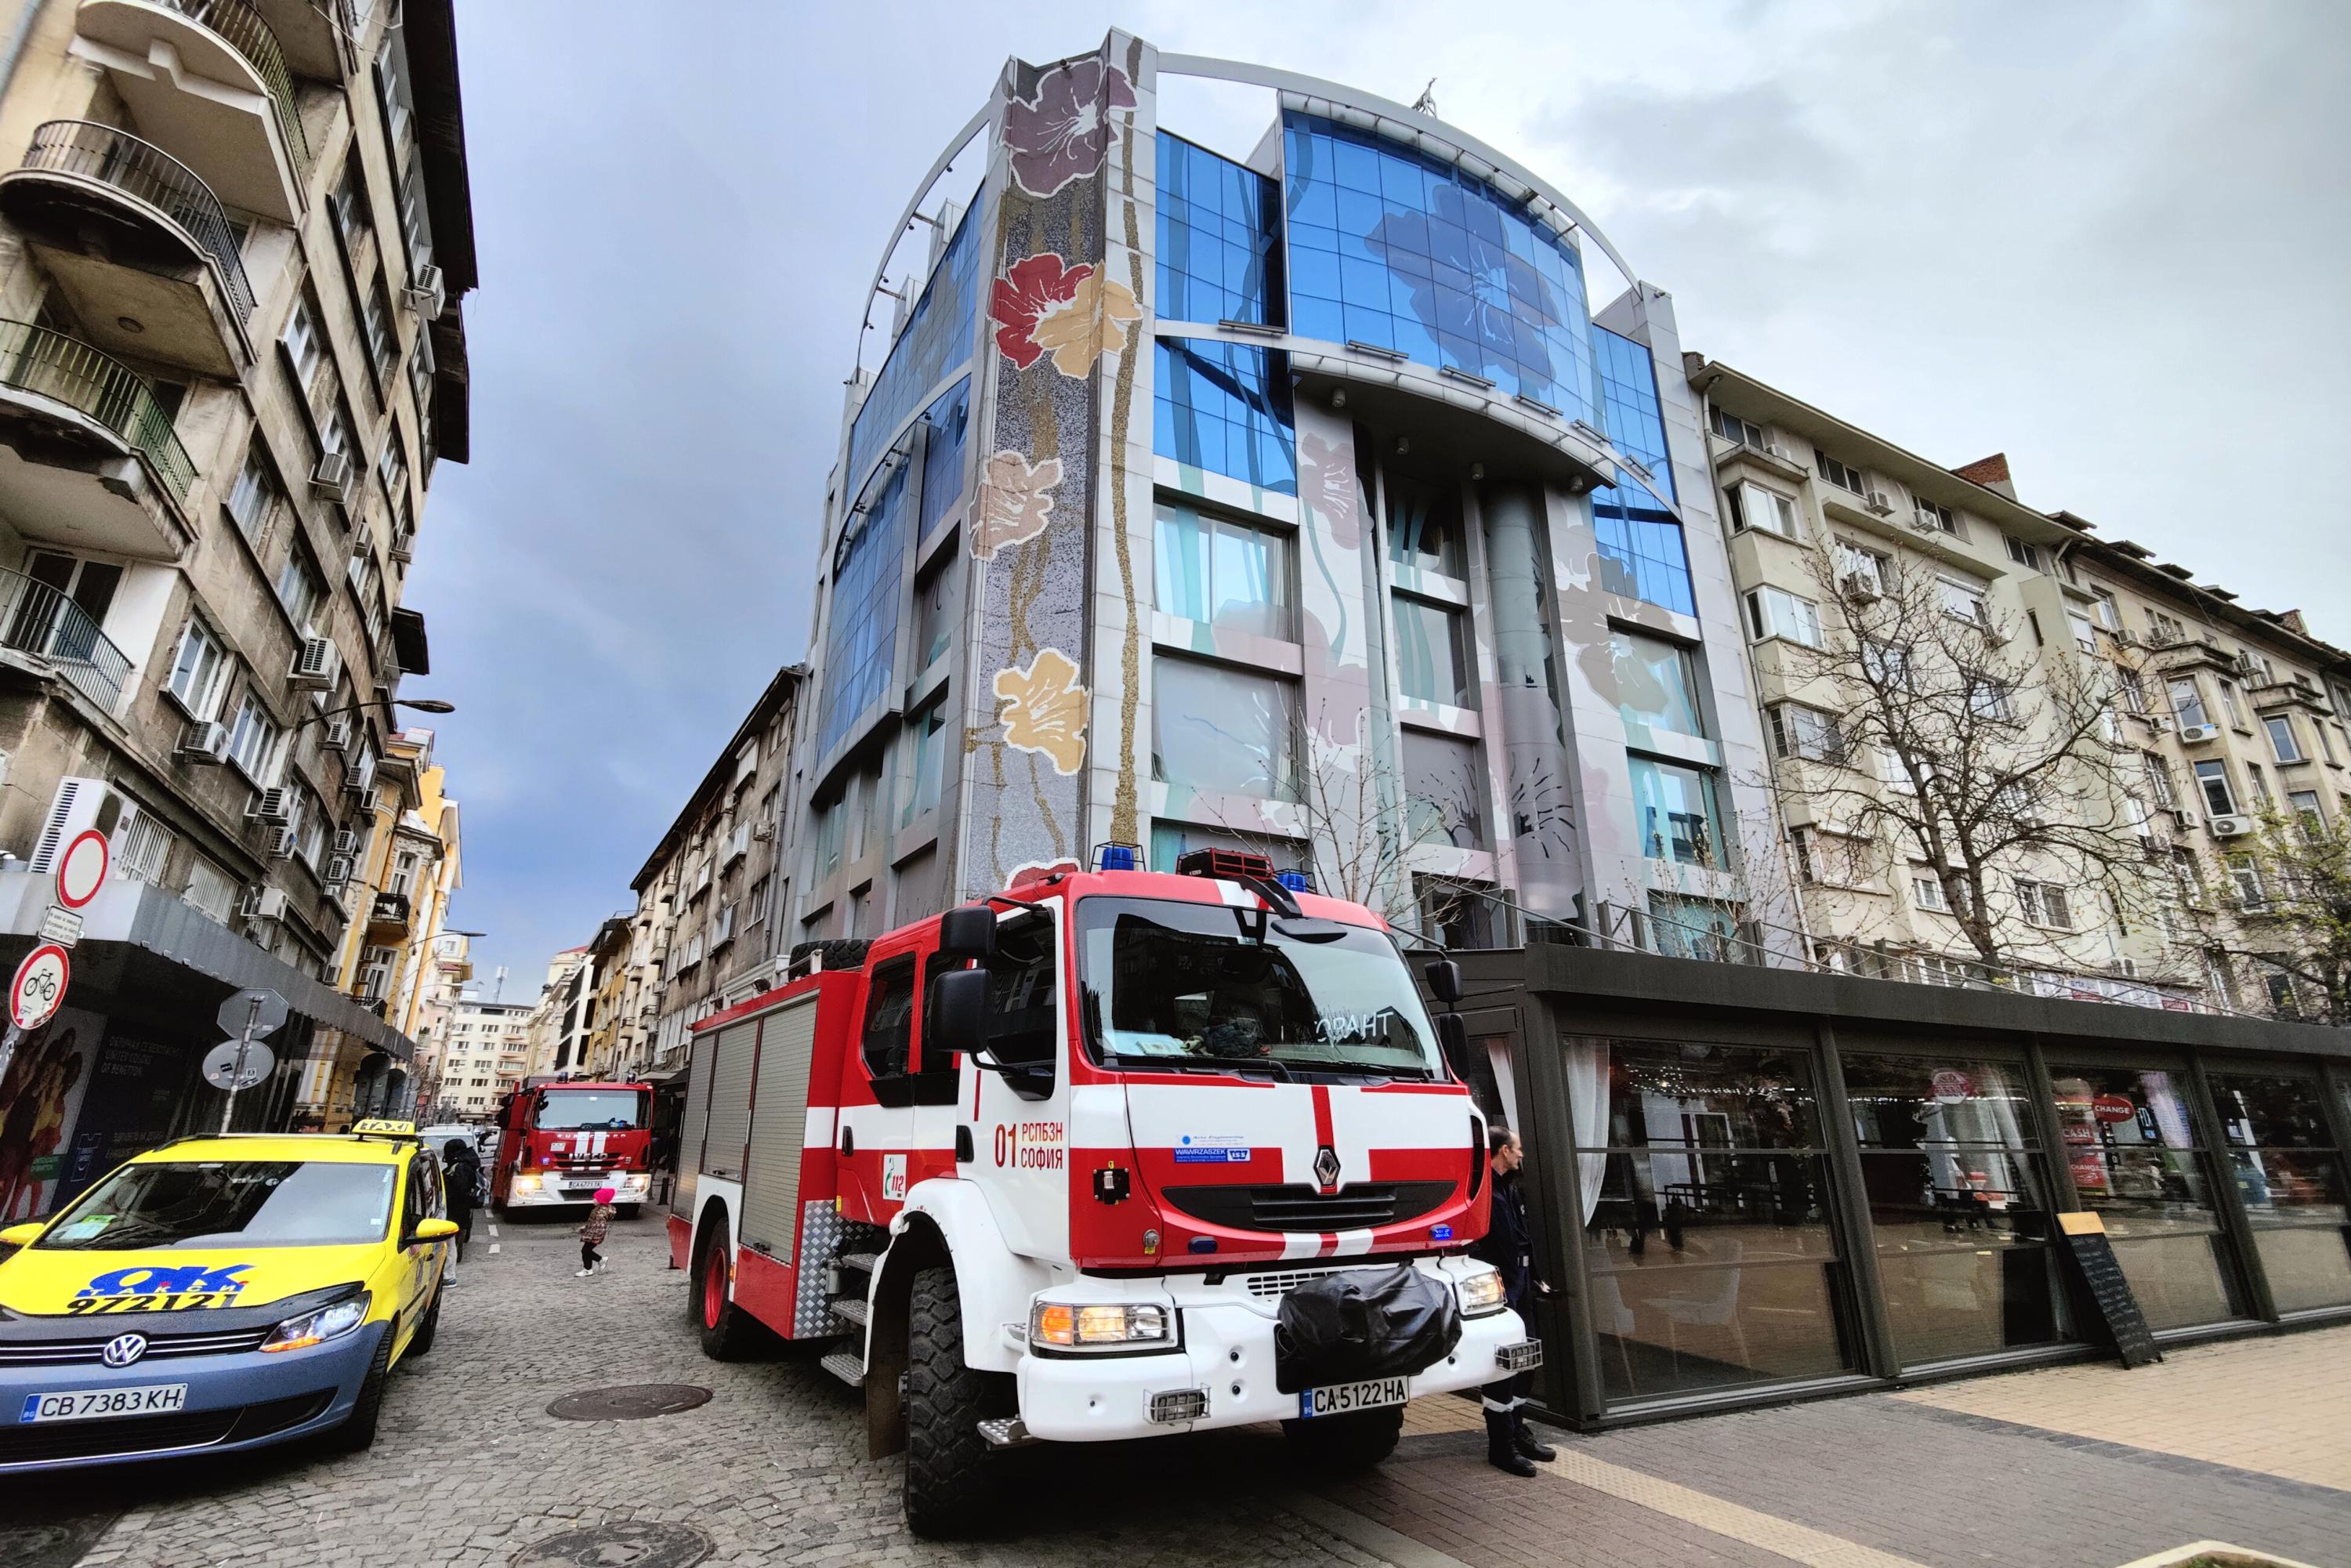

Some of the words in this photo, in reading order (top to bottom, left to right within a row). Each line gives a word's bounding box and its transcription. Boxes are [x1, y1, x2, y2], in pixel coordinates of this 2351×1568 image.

[2094, 1105, 2131, 1114] CHANGE
[360, 1121, 408, 1132] TAXI
[1022, 1122, 1062, 1142] РСПБЗН
[2063, 1128, 2090, 1138] CASH
[994, 1124, 1016, 1168] 01
[1020, 1146, 1063, 1170] СОФИЯ
[891, 1175, 903, 1191] 112
[42, 1397, 74, 1417] CB
[80, 1392, 143, 1414] 7383
[146, 1389, 180, 1410] KH
[1314, 1389, 1337, 1412] CA
[1340, 1382, 1382, 1408] 5122
[1384, 1379, 1405, 1403] HA
